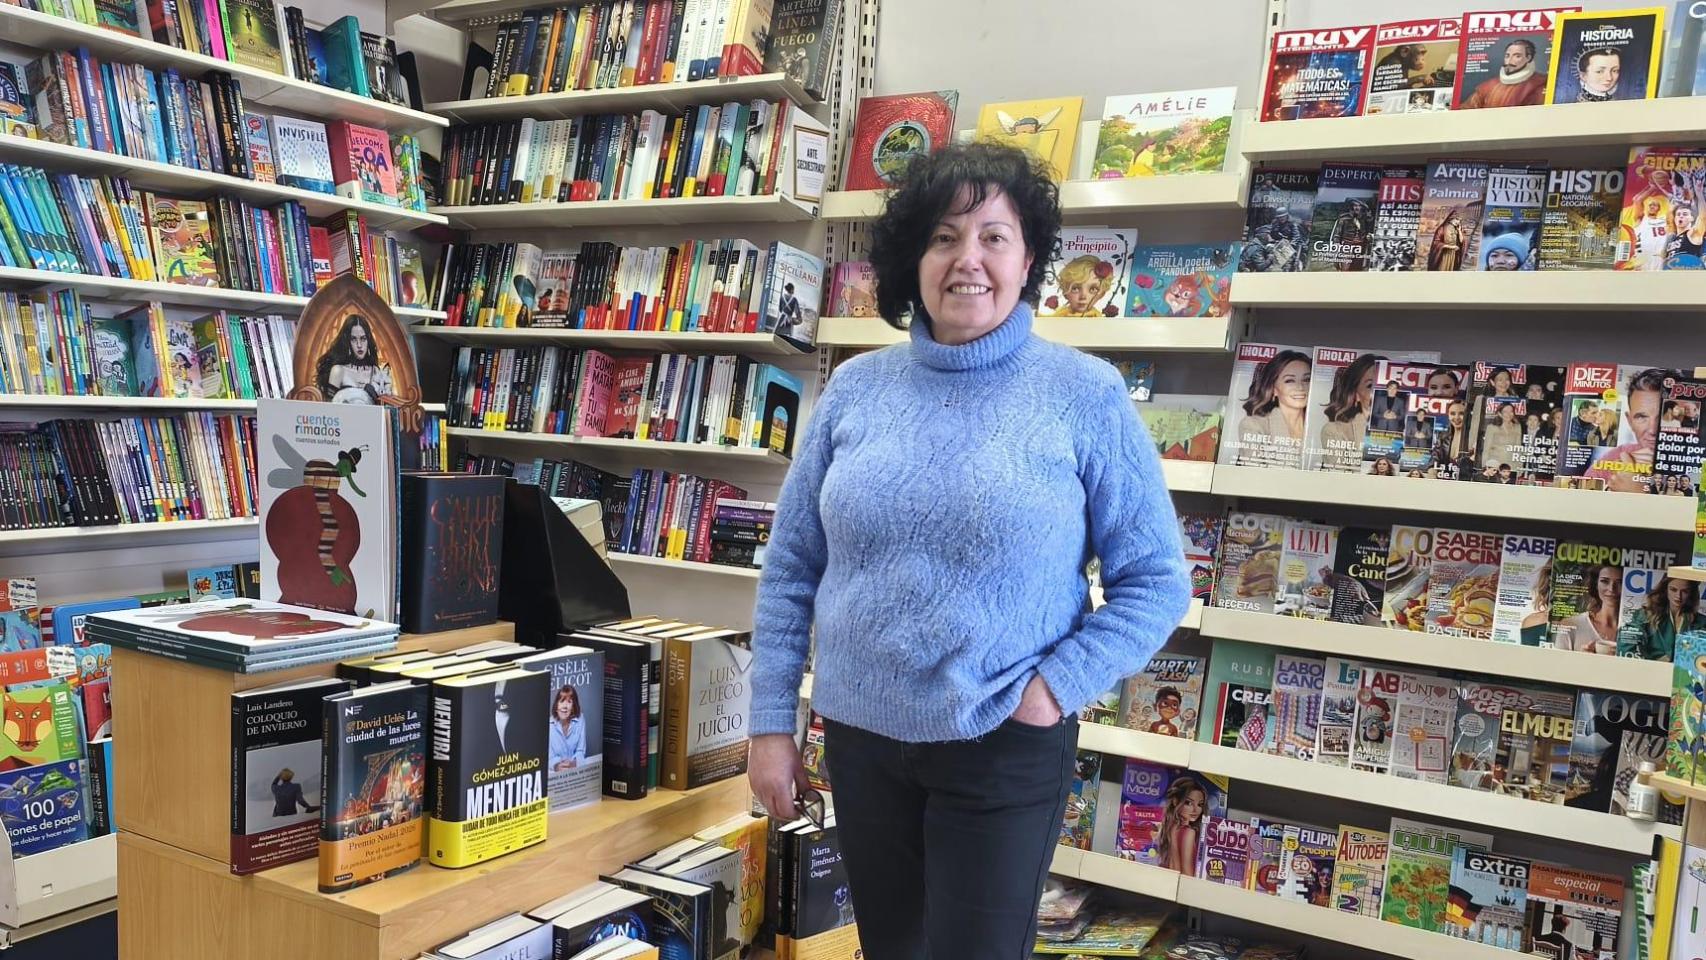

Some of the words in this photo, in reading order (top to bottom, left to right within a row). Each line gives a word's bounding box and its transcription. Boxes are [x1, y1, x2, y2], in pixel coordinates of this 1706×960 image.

[1276, 27, 1371, 49] muy
[1379, 24, 1437, 41] muy
[1580, 28, 1634, 42] HISTORIA
[773, 33, 815, 48] FUEGO
[1280, 80, 1351, 93] MATEMÁTICAS!
[1129, 97, 1208, 116] AMÉLIE
[1324, 168, 1381, 182] DESPERTA
[1549, 170, 1624, 193] HISTO
[1429, 188, 1479, 199] Palmira
[1066, 239, 1118, 253] Principito
[1313, 240, 1362, 253] Cabrera
[1147, 255, 1183, 268] ARDILLA
[779, 262, 818, 284] SICILIANA
[1241, 346, 1275, 358] ¡HOLA!
[1319, 349, 1355, 363] ¡HOLA!
[1575, 367, 1612, 381] DIEZ
[1573, 379, 1611, 389] MINUTOS
[296, 414, 340, 428] cuentos
[295, 423, 341, 438] rimados
[1243, 433, 1272, 444] ISABEL
[1327, 439, 1357, 450] ISABEL
[1659, 432, 1684, 444] Roto
[1686, 434, 1699, 444] de
[1507, 444, 1546, 456] amigas
[1658, 442, 1685, 453] dolor
[1686, 445, 1706, 455] por
[1512, 452, 1543, 464] Reina
[1656, 452, 1666, 461] la
[1655, 462, 1666, 471] de
[1668, 464, 1681, 472] su
[1218, 599, 1261, 611] RECETAS
[1427, 624, 1492, 640] PASTELES
[709, 664, 736, 685] LUIS
[1157, 671, 1190, 681] FLASH
[700, 682, 743, 704] ZUECO
[246, 701, 262, 712] Luis
[264, 700, 294, 710] Landero
[716, 703, 726, 716] EL
[246, 710, 298, 725] COLOQUIO
[356, 720, 381, 732] David
[383, 714, 405, 726] Uclés
[407, 712, 418, 720] La
[246, 726, 260, 736] DE
[261, 719, 307, 734] INVIERNO
[345, 731, 375, 744] ciudad
[376, 727, 388, 738] de
[388, 725, 401, 735] las
[402, 722, 422, 733] luces
[433, 696, 451, 761] MENTIRA
[697, 713, 742, 742] JUICIO
[389, 732, 422, 746] muertas
[496, 752, 519, 766] JUAN
[1297, 747, 1315, 761] 65
[472, 757, 540, 783] GÓMEZ-JURADO
[1128, 769, 1162, 784] TOP
[466, 771, 543, 822] MENTIRA
[1126, 783, 1160, 797] Model
[23, 799, 54, 820] 100
[39, 818, 53, 830] de
[55, 810, 81, 829] papel
[485, 815, 498, 828] TODO
[348, 836, 376, 850] Premio
[377, 829, 398, 844] Nadal
[811, 846, 831, 857] Marta
[810, 856, 836, 870] Jiménez
[1468, 855, 1527, 879] extra
[1553, 876, 1601, 893] especial
